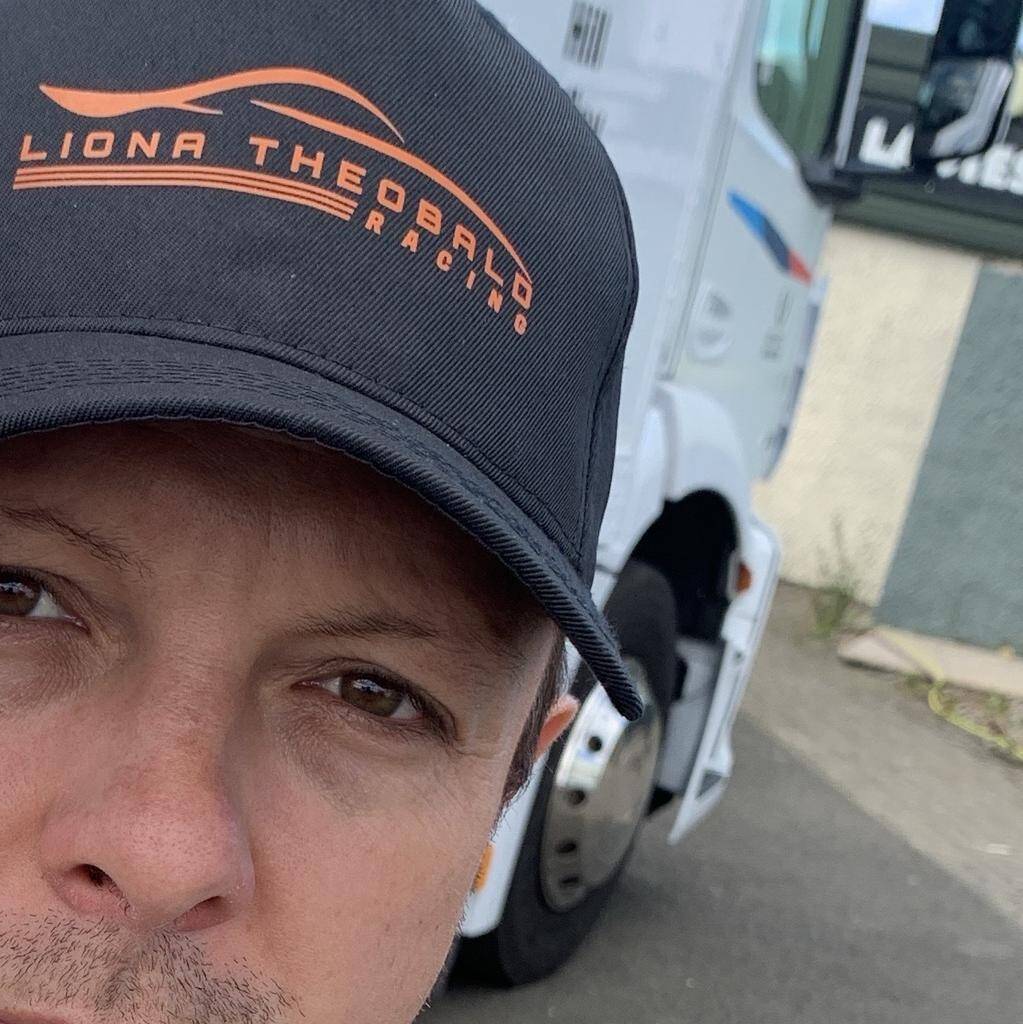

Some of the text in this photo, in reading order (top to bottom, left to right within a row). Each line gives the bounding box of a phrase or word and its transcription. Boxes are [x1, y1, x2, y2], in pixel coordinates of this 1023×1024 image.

[20, 131, 532, 309] LIONA THEOBALD
[364, 209, 527, 335] RACING
